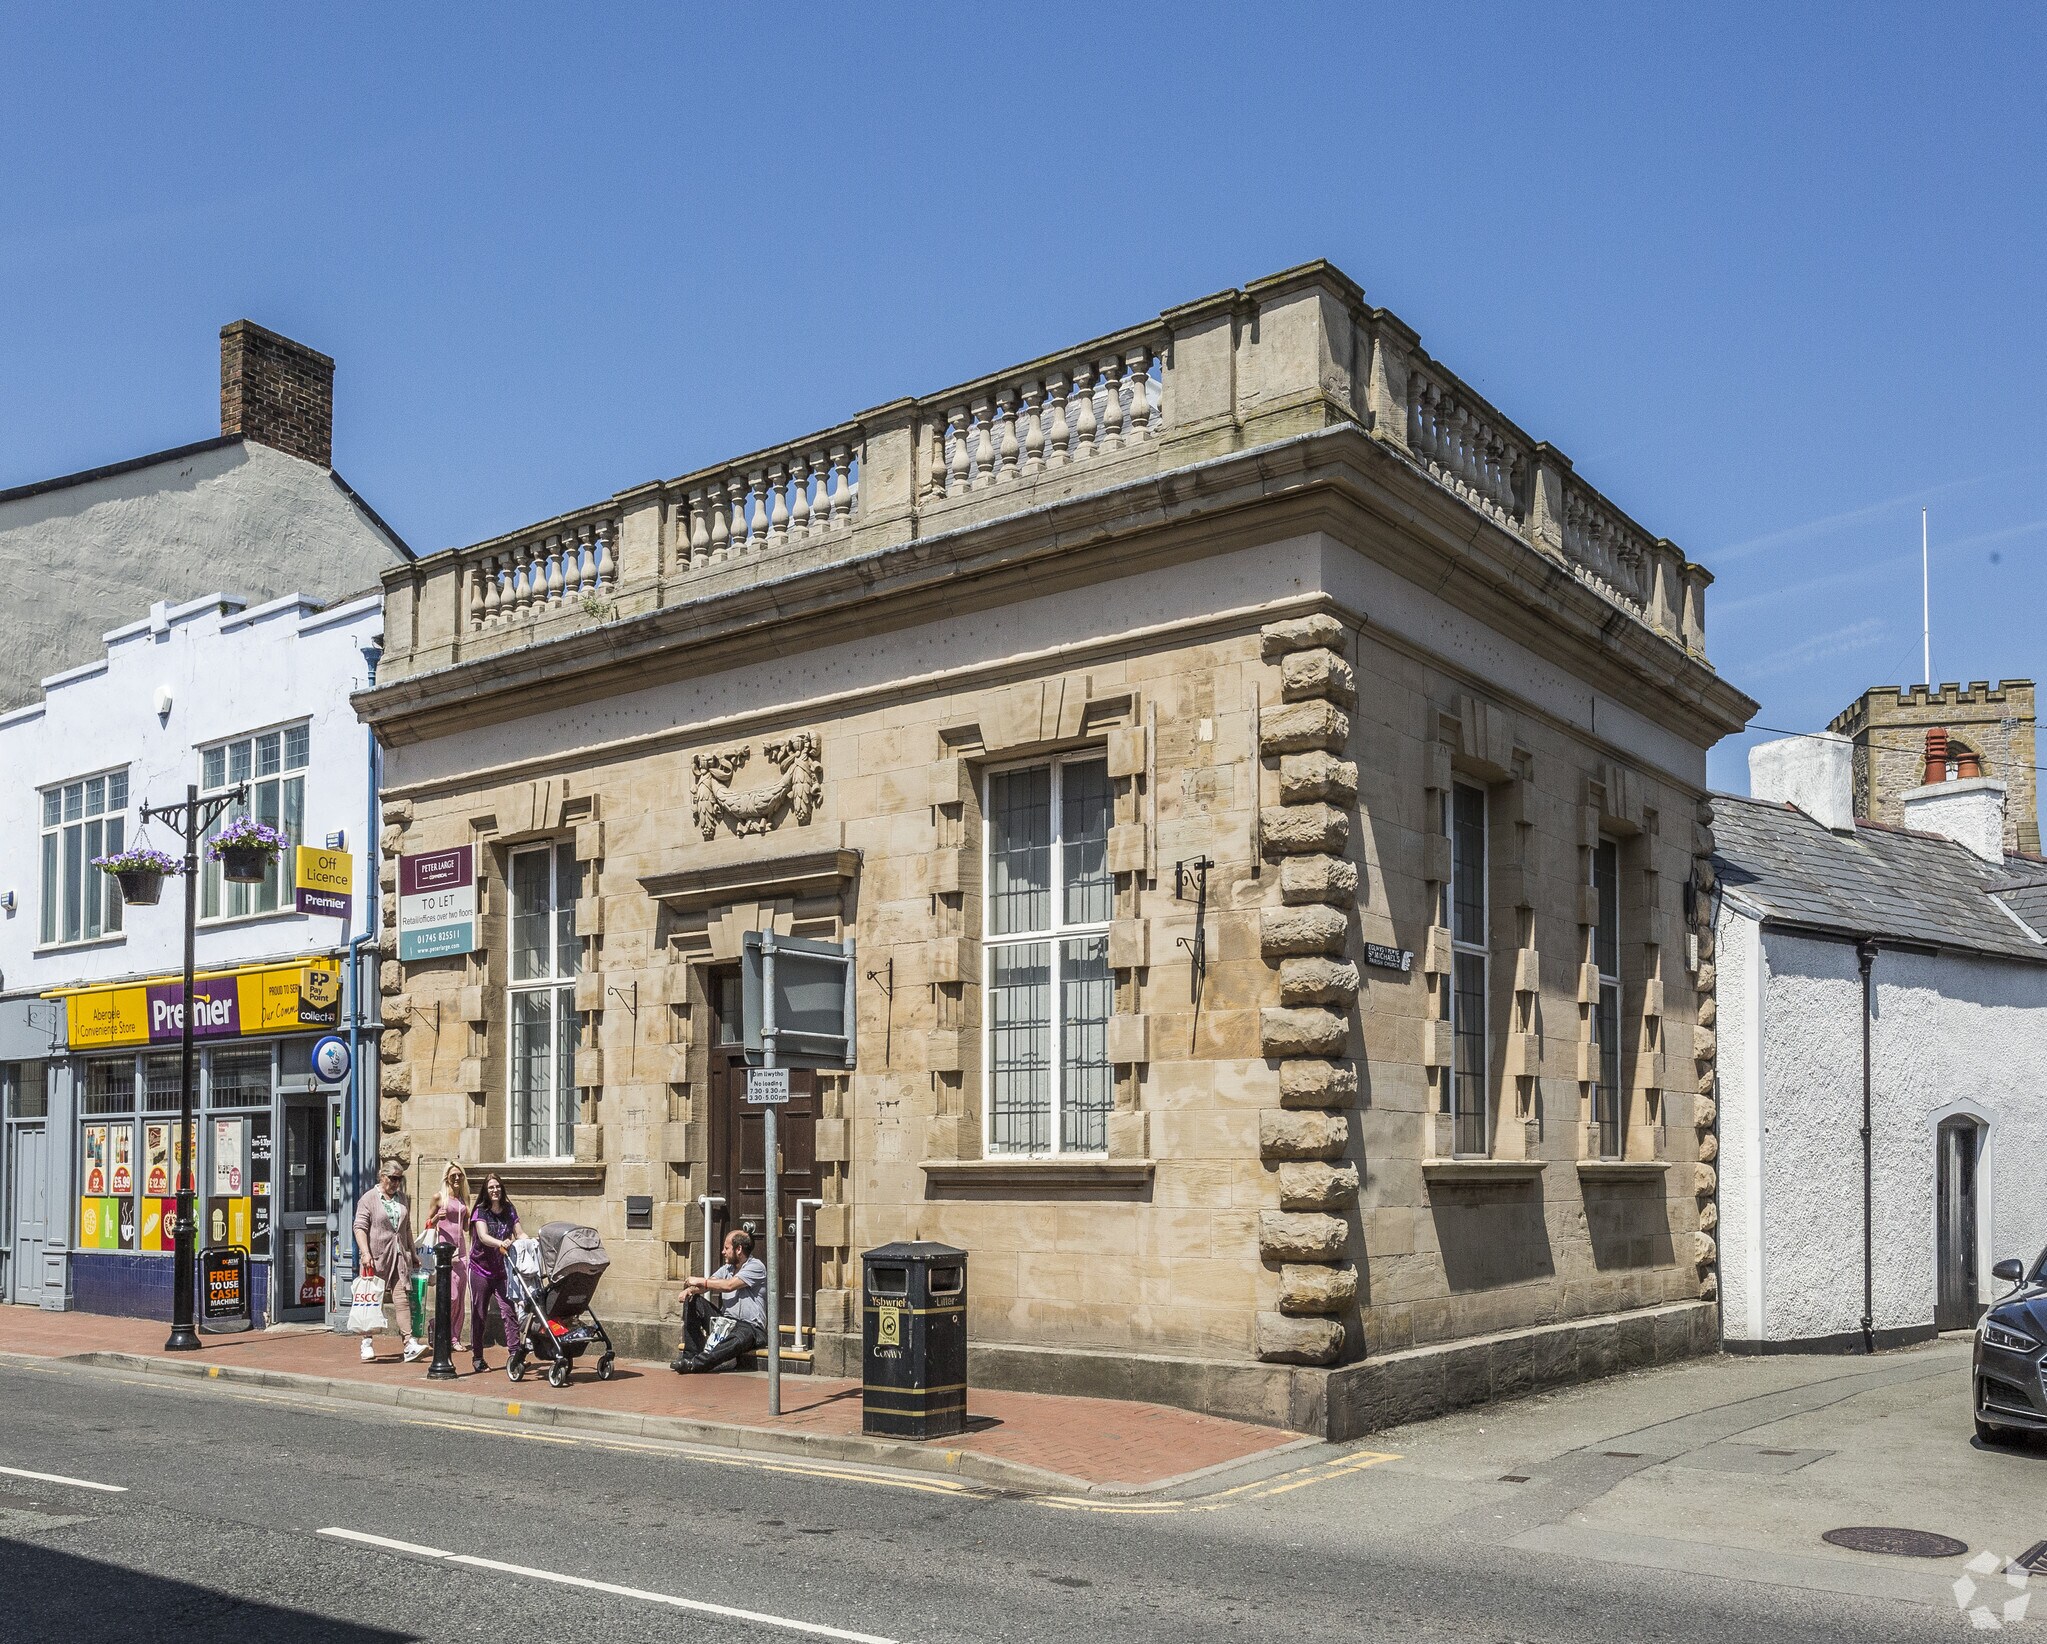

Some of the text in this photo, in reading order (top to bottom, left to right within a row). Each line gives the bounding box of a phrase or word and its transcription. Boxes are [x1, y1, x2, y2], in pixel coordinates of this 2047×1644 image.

[318, 856, 336, 870] Off
[421, 860, 454, 873] PETER LARGE
[307, 868, 348, 885] Licence
[305, 894, 346, 909] Premier
[422, 894, 454, 910] TO LET
[436, 912, 448, 922] over
[448, 910, 458, 919] two
[458, 908, 473, 917] floors
[417, 930, 460, 944] 01745 825511
[417, 943, 460, 954] www.peterlarge.com
[268, 984, 298, 996] PROUD TO SER
[310, 986, 322, 995] Pay
[310, 994, 328, 1002] Point
[94, 1008, 120, 1023] Abergele
[153, 998, 232, 1031] Premier
[262, 1008, 274, 1022] Our
[80, 1020, 135, 1037] Convenience Store
[92, 1178, 99, 1188] £2
[114, 1176, 130, 1188] £5.99
[149, 1178, 166, 1189] £12.99
[231, 1175, 239, 1186] £2
[210, 1270, 238, 1282] FREE
[210, 1280, 238, 1290] TO USE
[210, 1288, 239, 1300] CASH
[210, 1298, 239, 1306] MACHINE
[874, 1346, 903, 1359] CONWY
